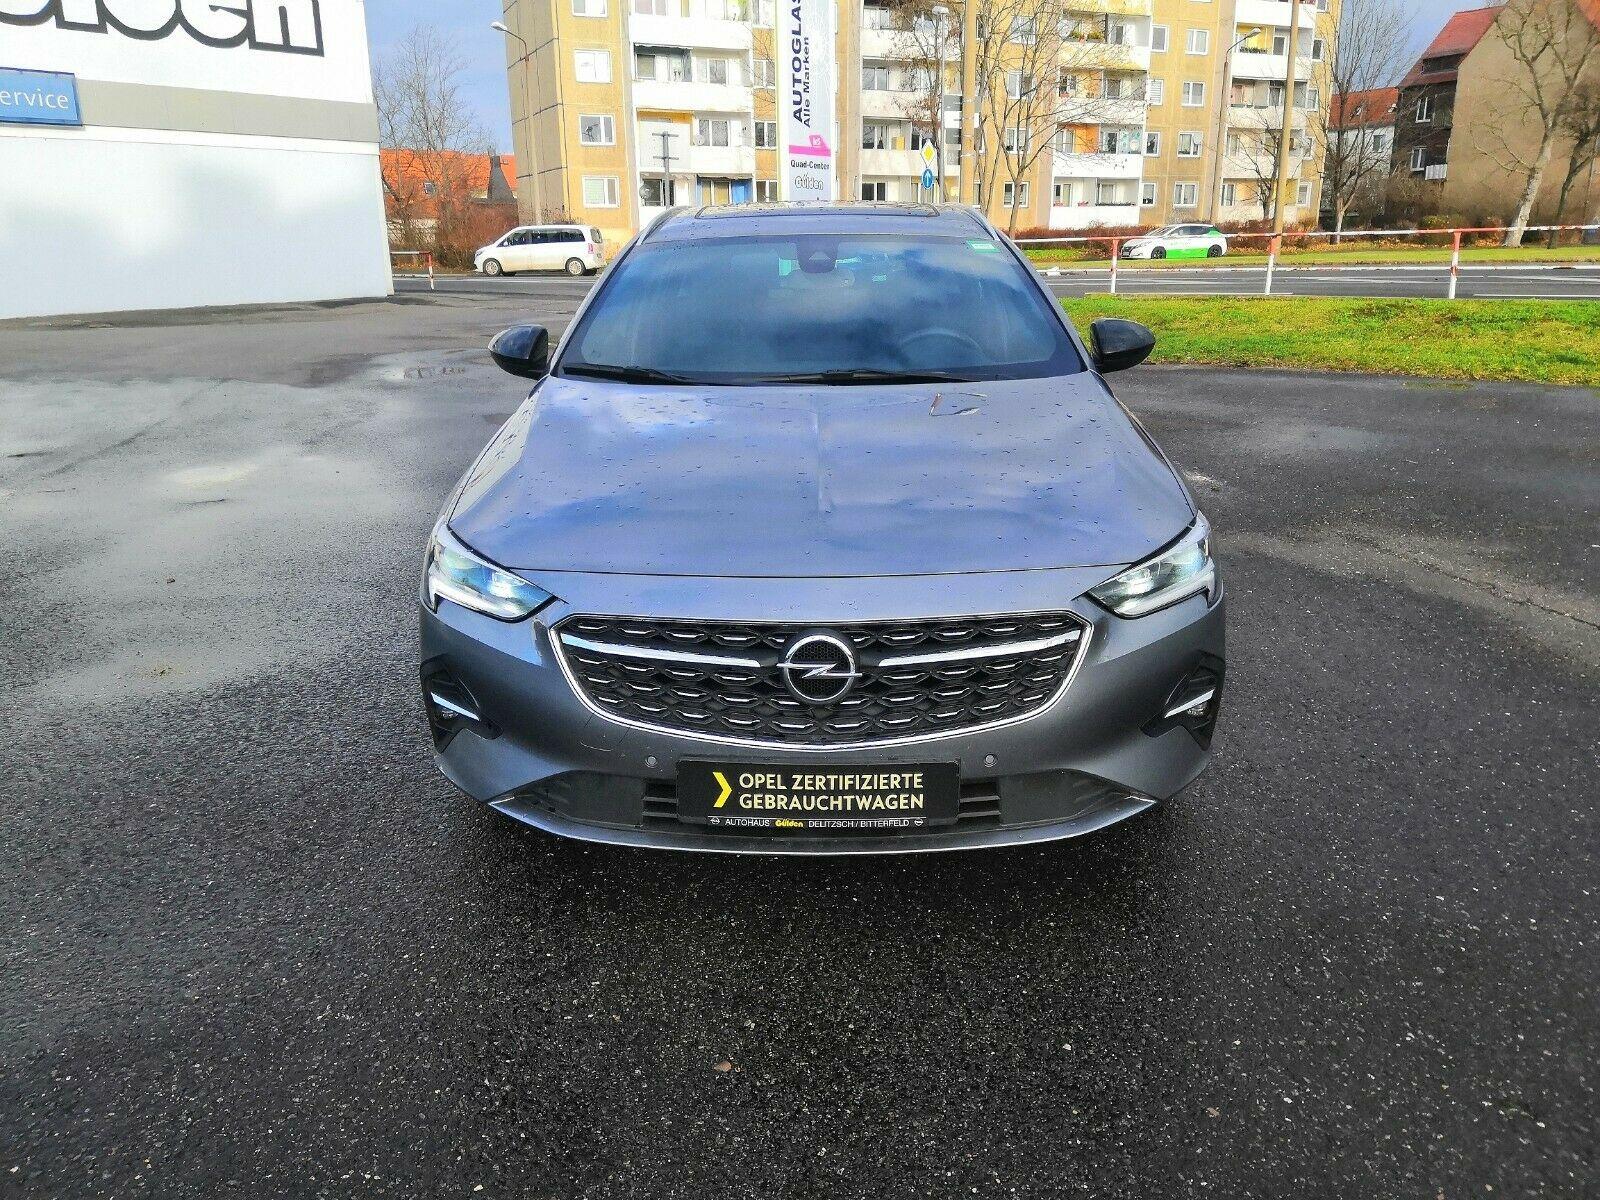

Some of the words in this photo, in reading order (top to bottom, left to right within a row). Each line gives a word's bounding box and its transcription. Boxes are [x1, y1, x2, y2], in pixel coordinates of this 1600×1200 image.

[803, 99, 811, 128] Alle
[790, 159, 830, 170] Quad-Center
[794, 172, 824, 190] Gülden
[739, 773, 786, 789] OPEL
[791, 773, 924, 790] ZERTIFIZIERTE
[739, 794, 924, 810] GEBRAUCHTWAGEN
[725, 818, 771, 827] AUTOHAUS
[775, 818, 804, 828] Gülden
[808, 820, 854, 828] DELITZSCH
[860, 819, 910, 828] BITTERFELD
